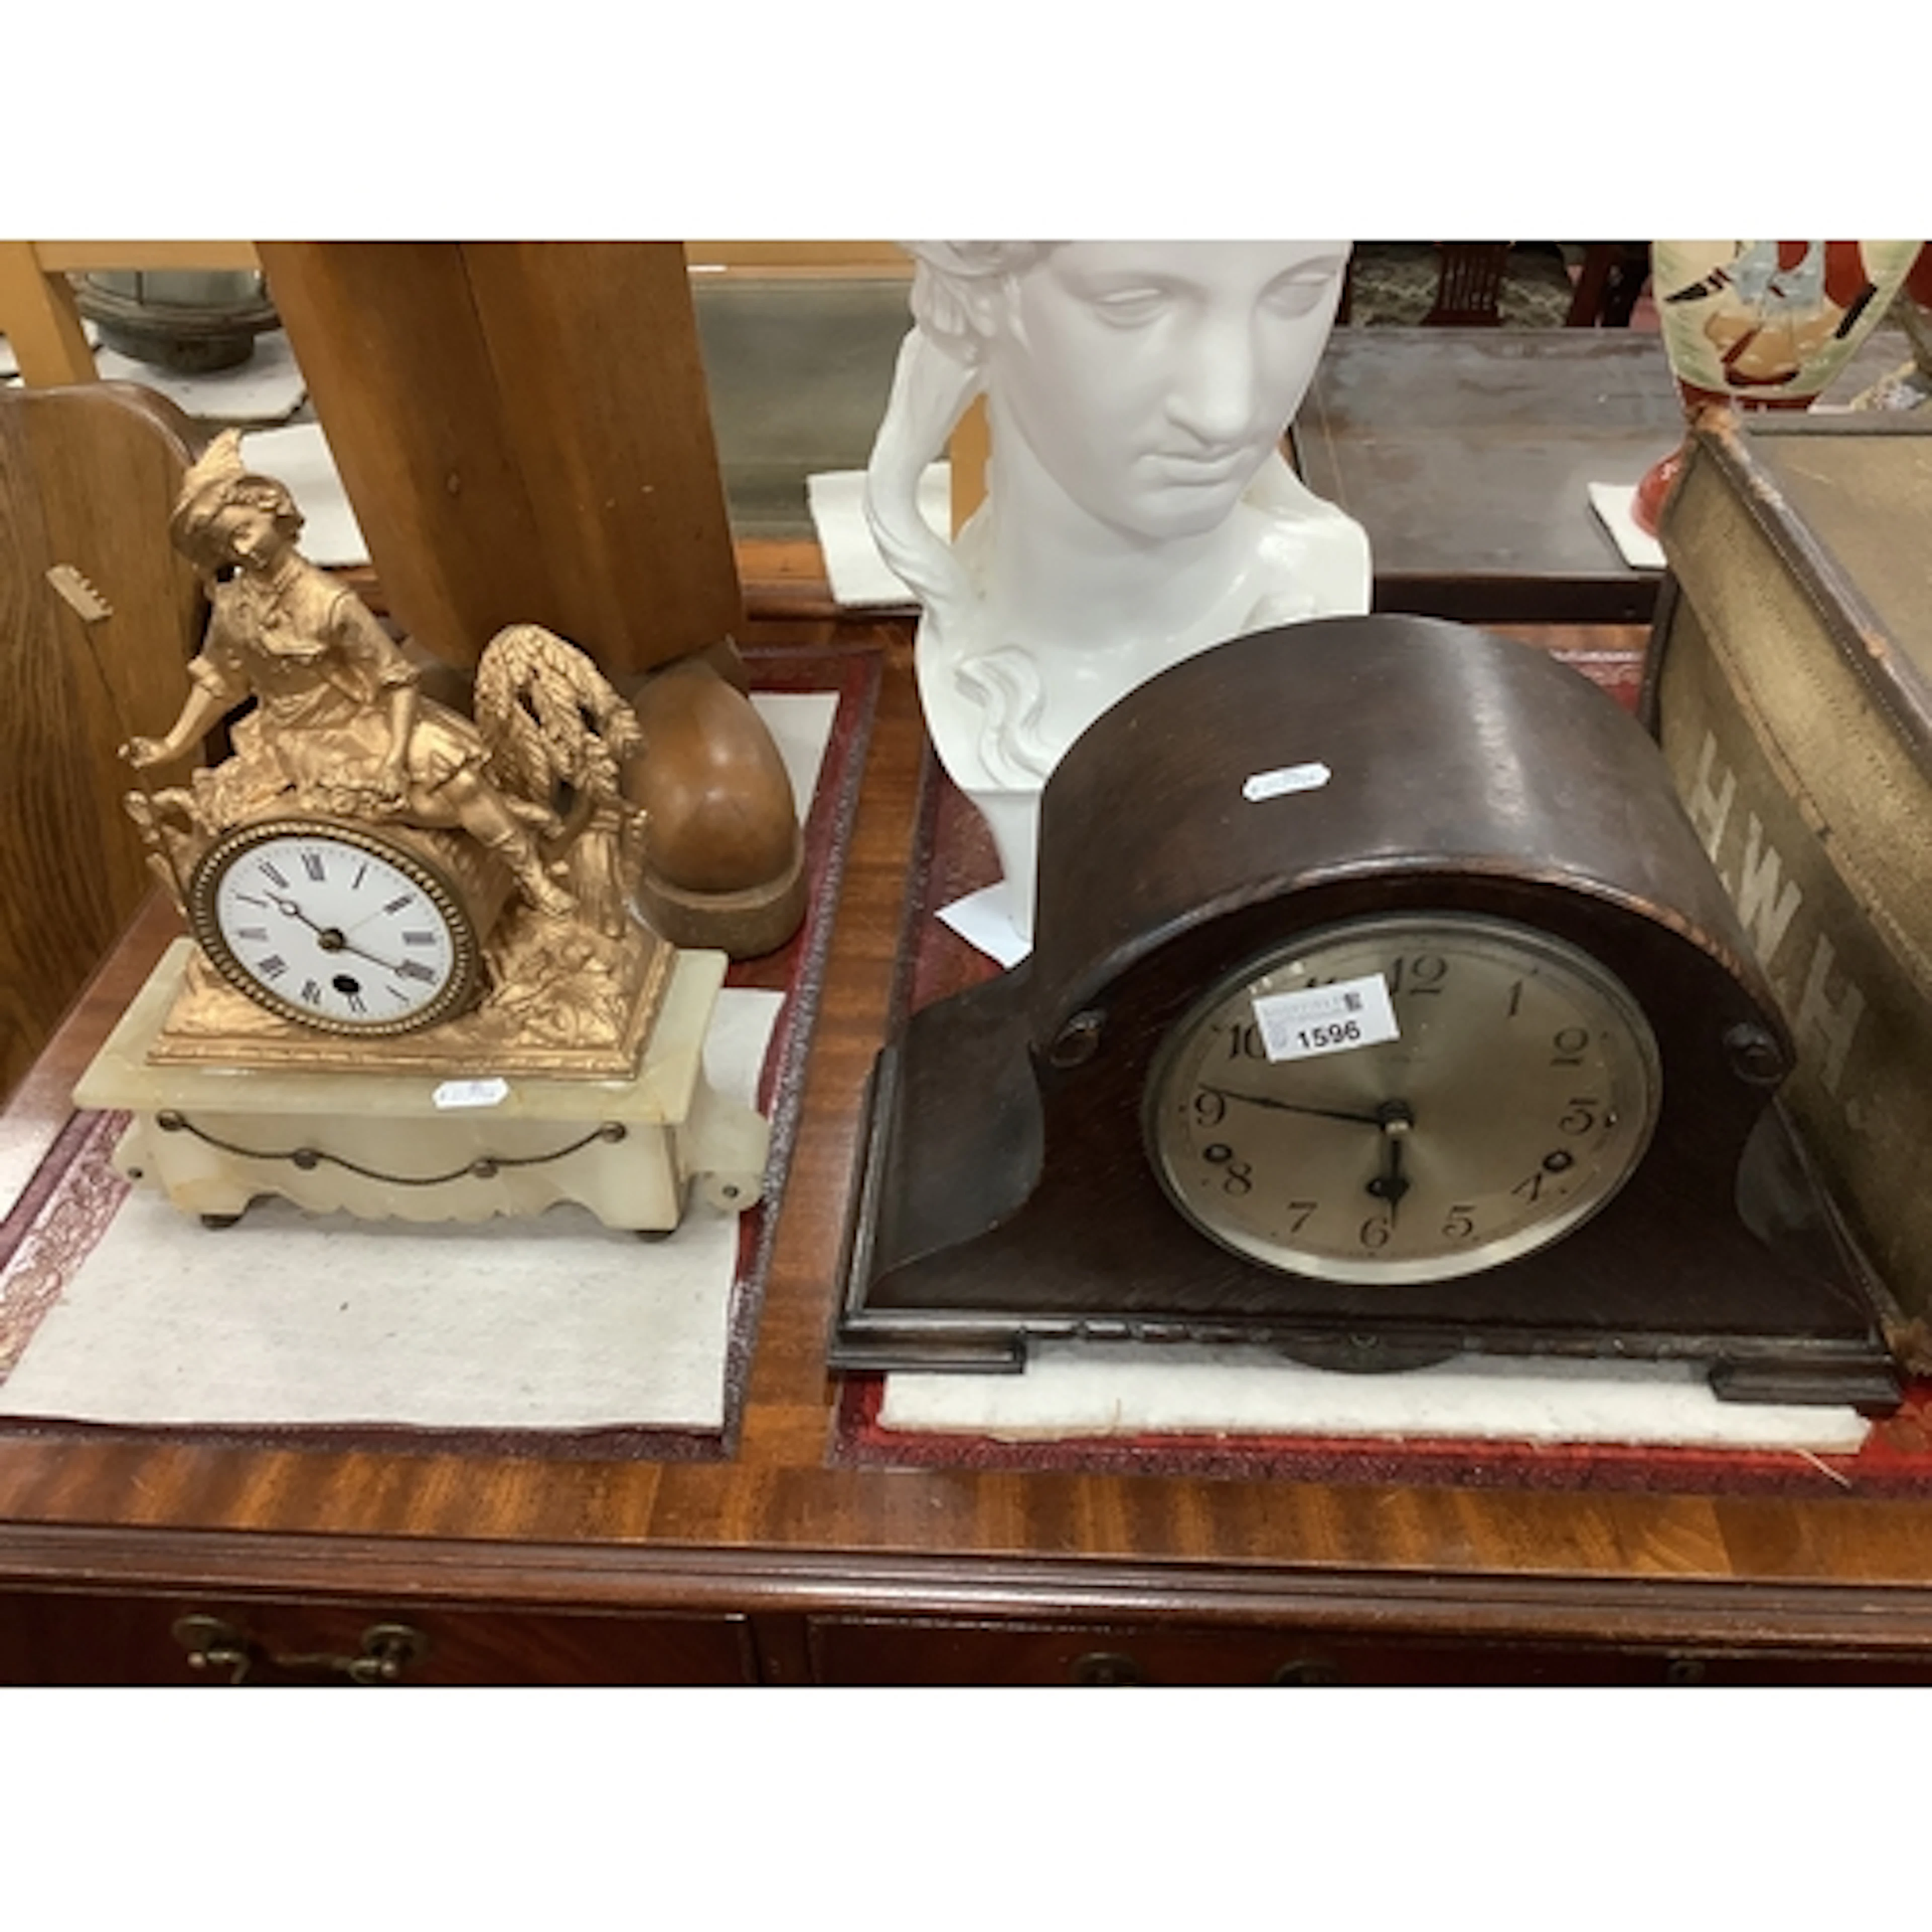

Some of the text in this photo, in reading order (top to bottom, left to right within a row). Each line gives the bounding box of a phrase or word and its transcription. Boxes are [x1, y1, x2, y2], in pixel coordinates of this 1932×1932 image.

[1391, 954, 1450, 997] 12
[1509, 981, 1523, 1017] 1
[1298, 1020, 1361, 1048] 1596
[1550, 1026, 1589, 1066] 2
[1195, 1091, 1226, 1128] 9
[1224, 1162, 1252, 1196] 8
[1287, 1201, 1318, 1234] 7
[1360, 1216, 1390, 1249] 6
[1441, 1204, 1478, 1238] 5
